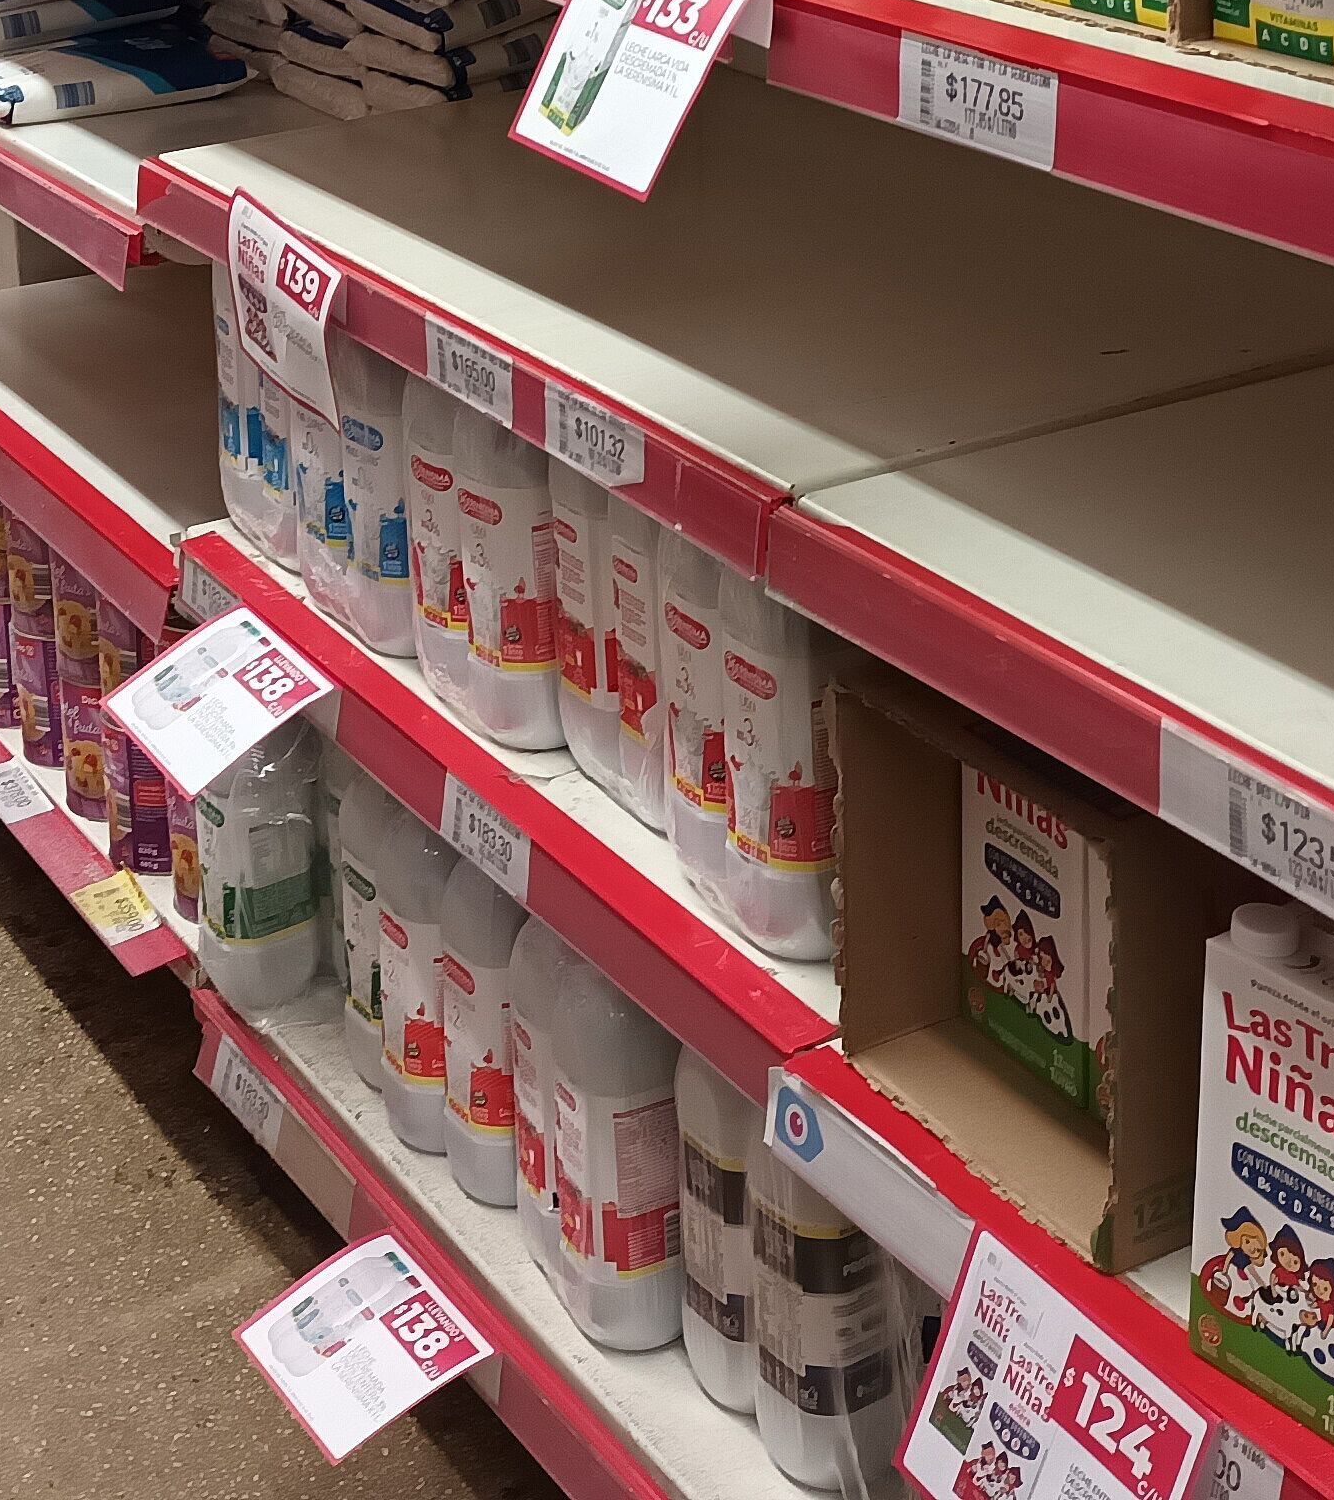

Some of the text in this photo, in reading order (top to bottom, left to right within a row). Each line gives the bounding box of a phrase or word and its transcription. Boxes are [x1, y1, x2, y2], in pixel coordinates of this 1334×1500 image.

[945, 74, 1023, 120] $177,85
[575, 417, 625, 462] $101,32
[986, 818, 1059, 878] descremada
[1221, 991, 1292, 1048] Las
[1097, 1361, 1160, 1423] LLEVANDO
